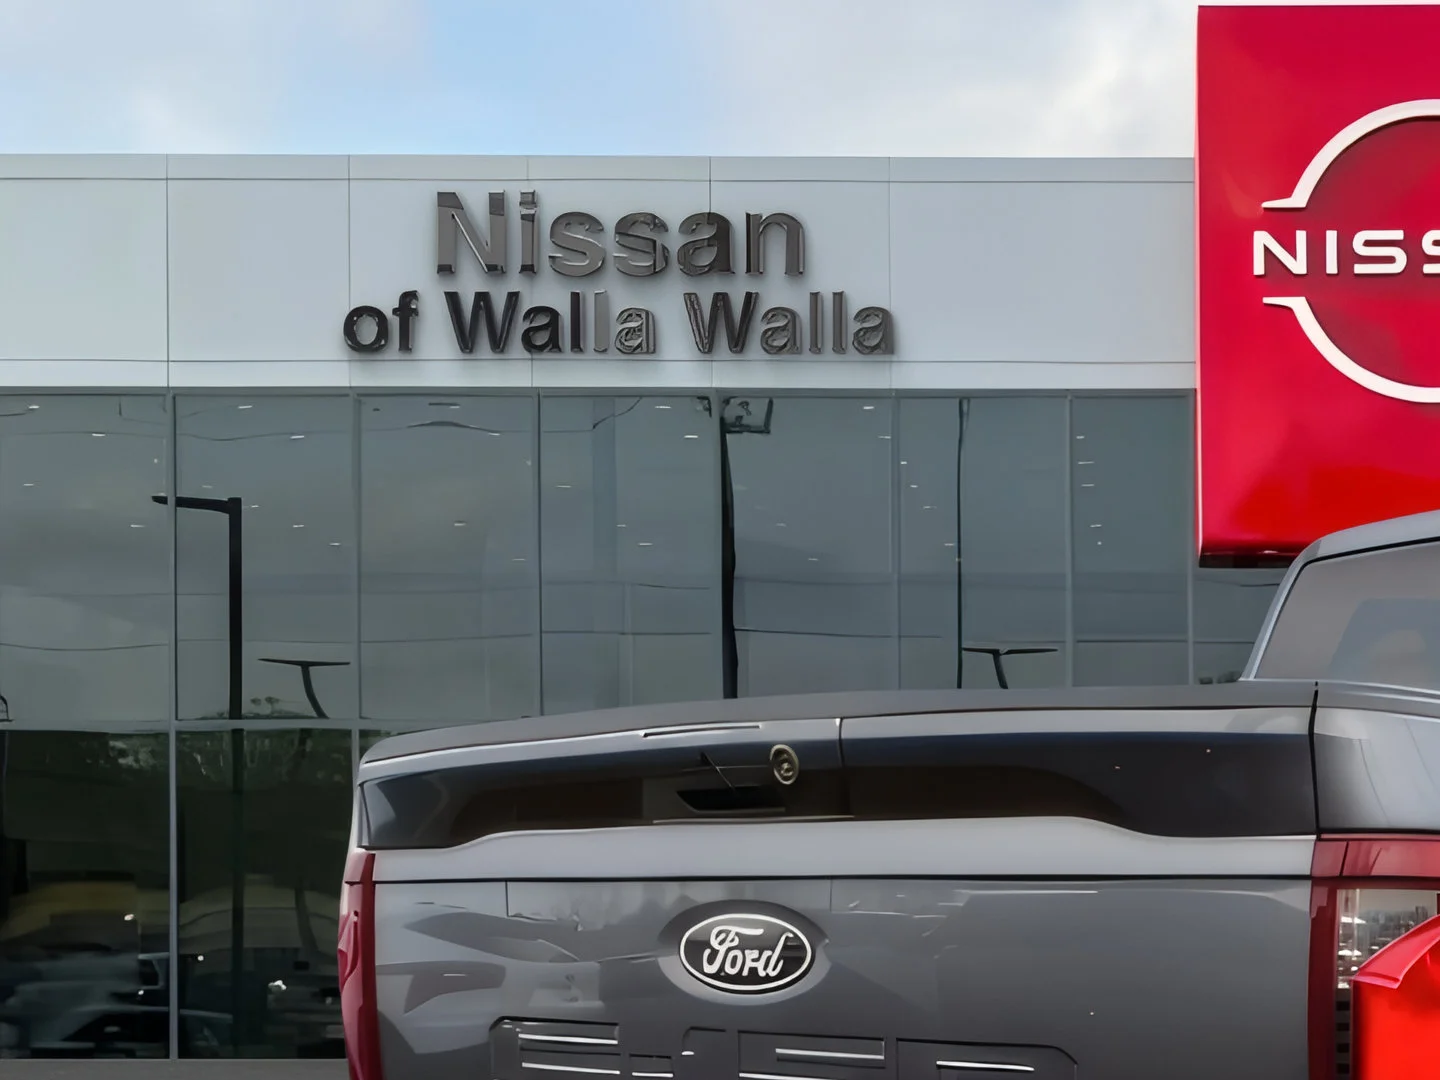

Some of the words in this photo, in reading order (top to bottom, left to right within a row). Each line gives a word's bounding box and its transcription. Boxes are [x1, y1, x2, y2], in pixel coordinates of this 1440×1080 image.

[436, 189, 806, 277] Nissan
[342, 290, 421, 354] of
[443, 290, 657, 355] Walla
[683, 290, 895, 355] Walla
[702, 925, 795, 978] Ford
